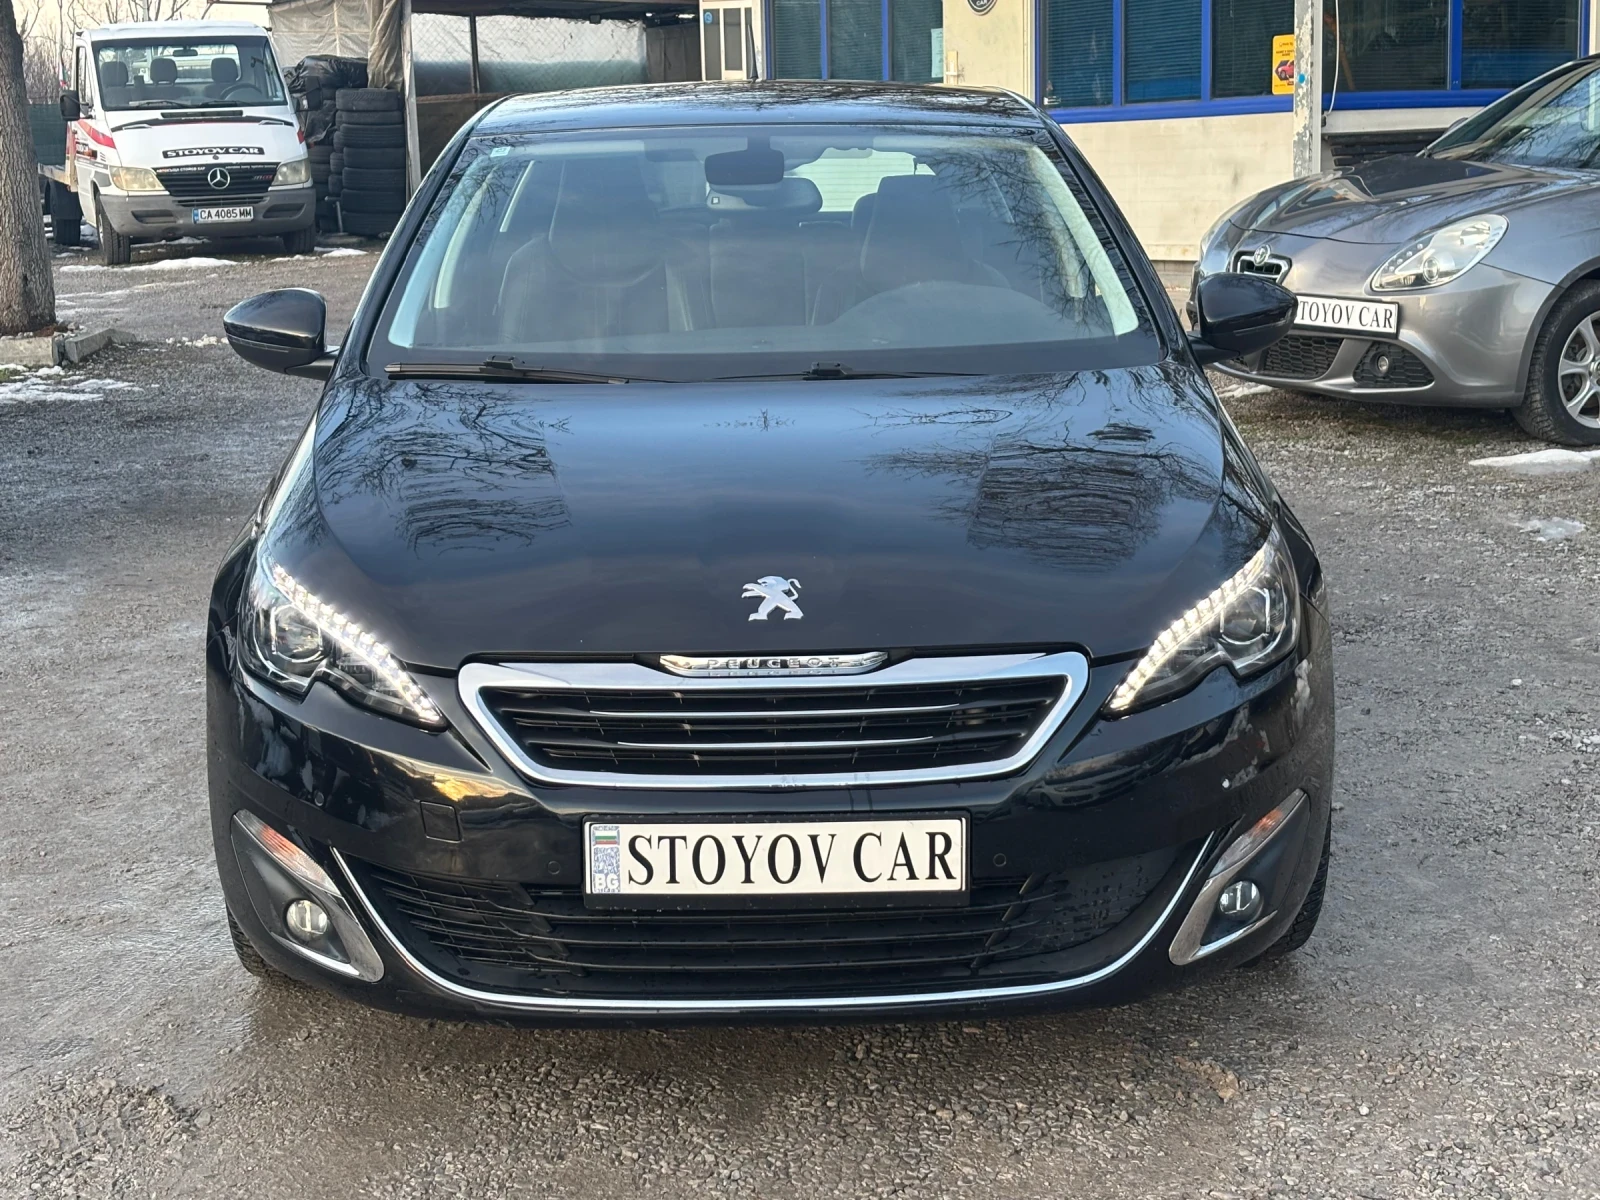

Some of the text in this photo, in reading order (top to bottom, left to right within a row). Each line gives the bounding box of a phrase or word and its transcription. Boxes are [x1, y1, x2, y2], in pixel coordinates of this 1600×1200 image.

[167, 147, 226, 157] STOYOV
[200, 208, 252, 220] CA 4085 MM
[1299, 300, 1393, 329] TOYOV CAR
[707, 656, 841, 669] PEUGEOT
[627, 831, 957, 886] STOYOV CAR
[595, 873, 619, 889] BG
